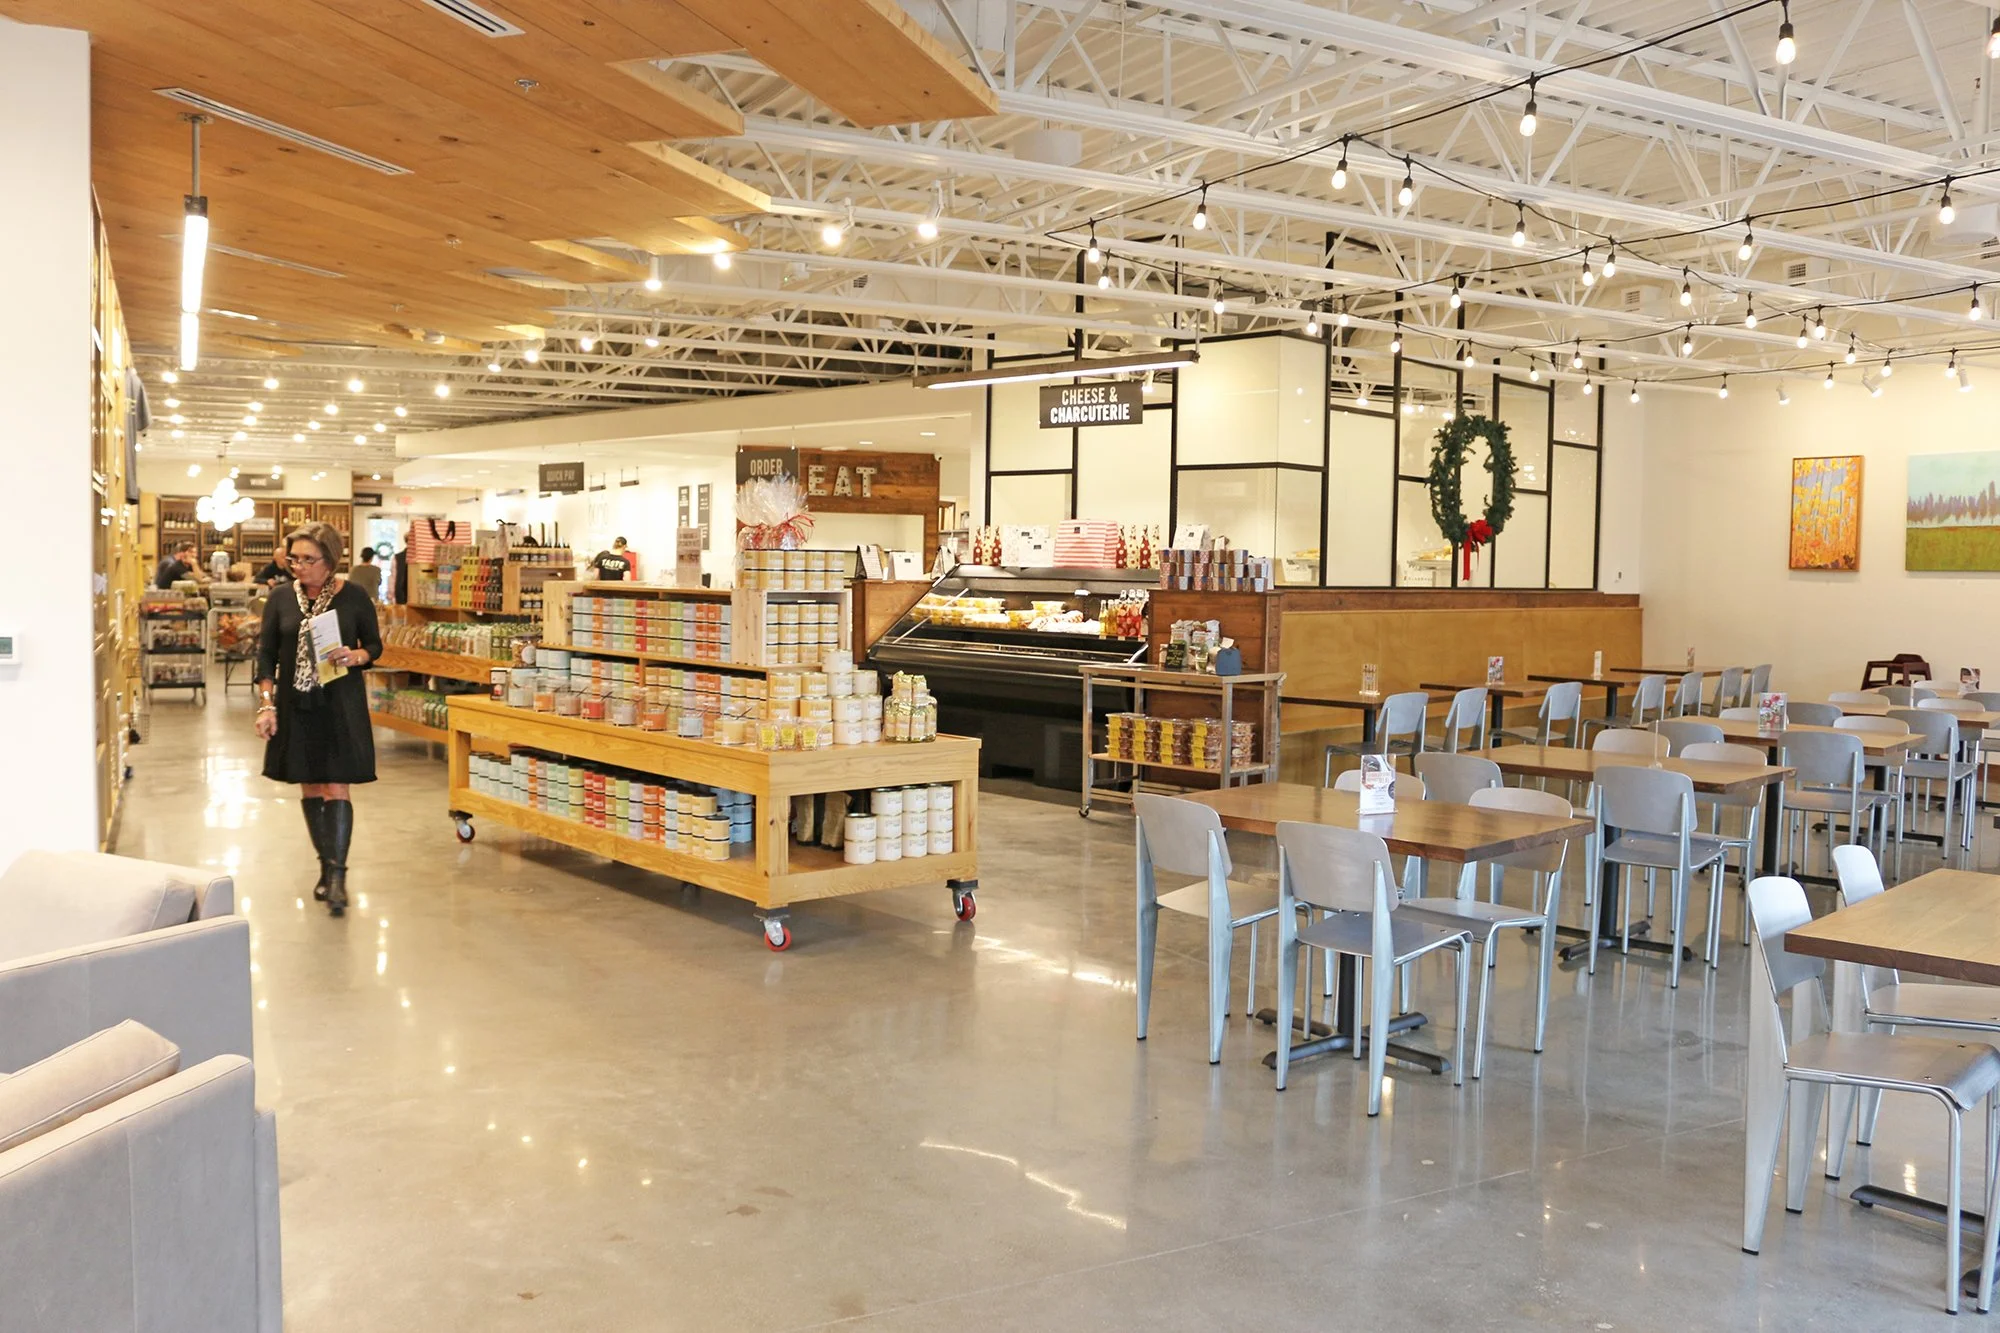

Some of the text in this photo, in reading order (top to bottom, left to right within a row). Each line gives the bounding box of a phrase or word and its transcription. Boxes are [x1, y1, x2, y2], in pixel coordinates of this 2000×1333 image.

[1061, 386, 1118, 405] CHEESE &
[1050, 403, 1130, 424] CHARCUTERIE
[750, 458, 783, 476] ORDER
[808, 464, 877, 498] EAT
[601, 559, 625, 569] TASTE
